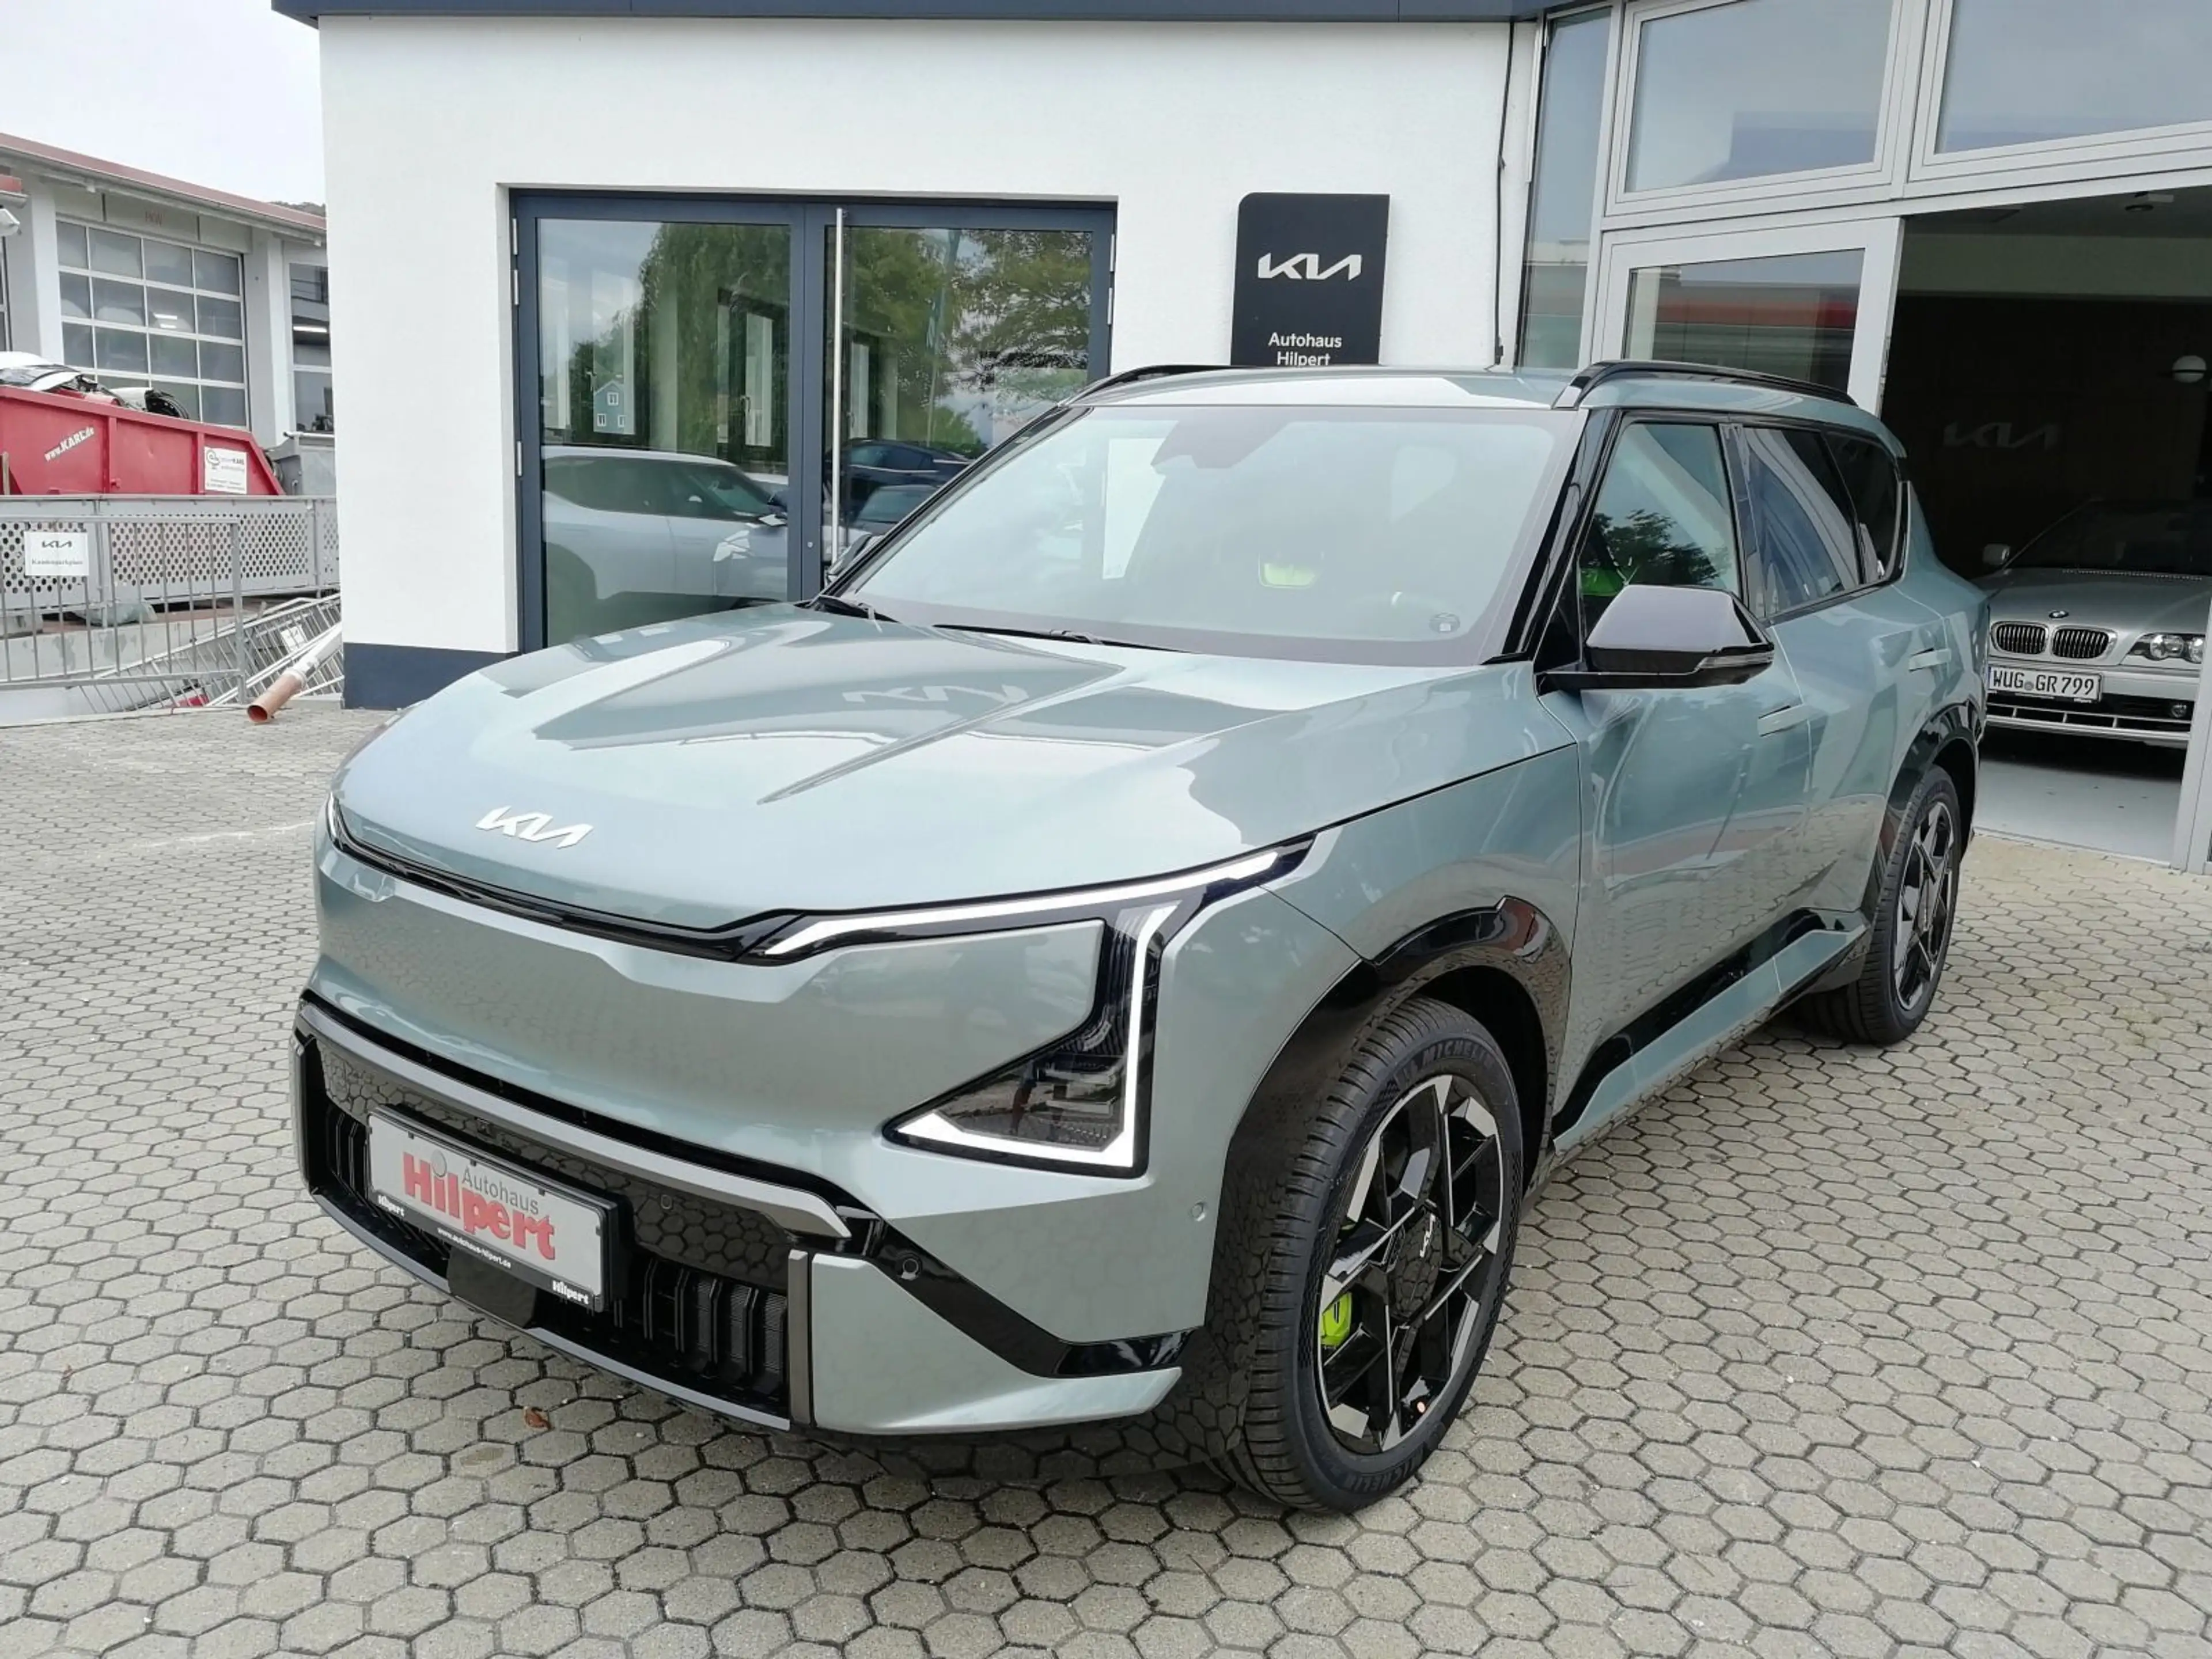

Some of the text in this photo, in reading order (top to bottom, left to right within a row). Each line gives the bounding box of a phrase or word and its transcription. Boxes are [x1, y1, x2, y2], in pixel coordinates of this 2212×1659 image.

[1258, 252, 1362, 281] KIA
[1268, 332, 1342, 348] Autohaus
[1277, 351, 1331, 366] Hilpert
[1943, 421, 2062, 451] KIA
[42, 540, 72, 548] KIA
[1993, 670, 2094, 696] WUG GR 799
[475, 805, 594, 850] KIA
[463, 1167, 539, 1215] Autohaus
[403, 1151, 555, 1260] Hilpert
[552, 1279, 589, 1305] Hilpert
